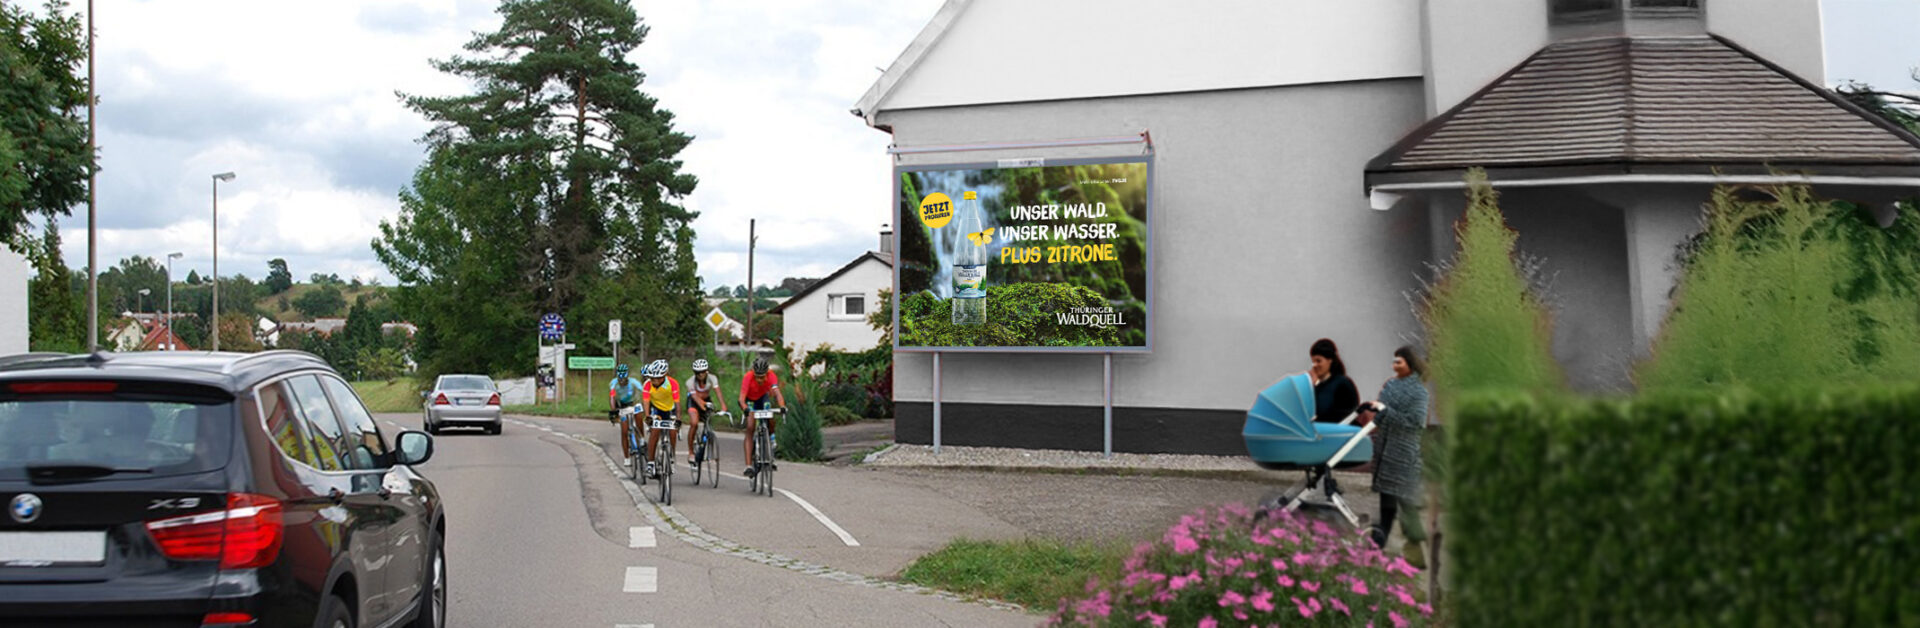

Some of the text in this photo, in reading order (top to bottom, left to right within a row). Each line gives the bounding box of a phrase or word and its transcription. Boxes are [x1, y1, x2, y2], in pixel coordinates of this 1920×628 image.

[923, 201, 950, 215] JETZT
[1010, 201, 1108, 221] UNSER WALD.
[1000, 223, 1120, 241] UNSER WASSER.
[1001, 243, 1118, 264] PLUS ZITRONE.
[1056, 312, 1127, 329] WALDQUELL
[147, 497, 200, 509] X3
